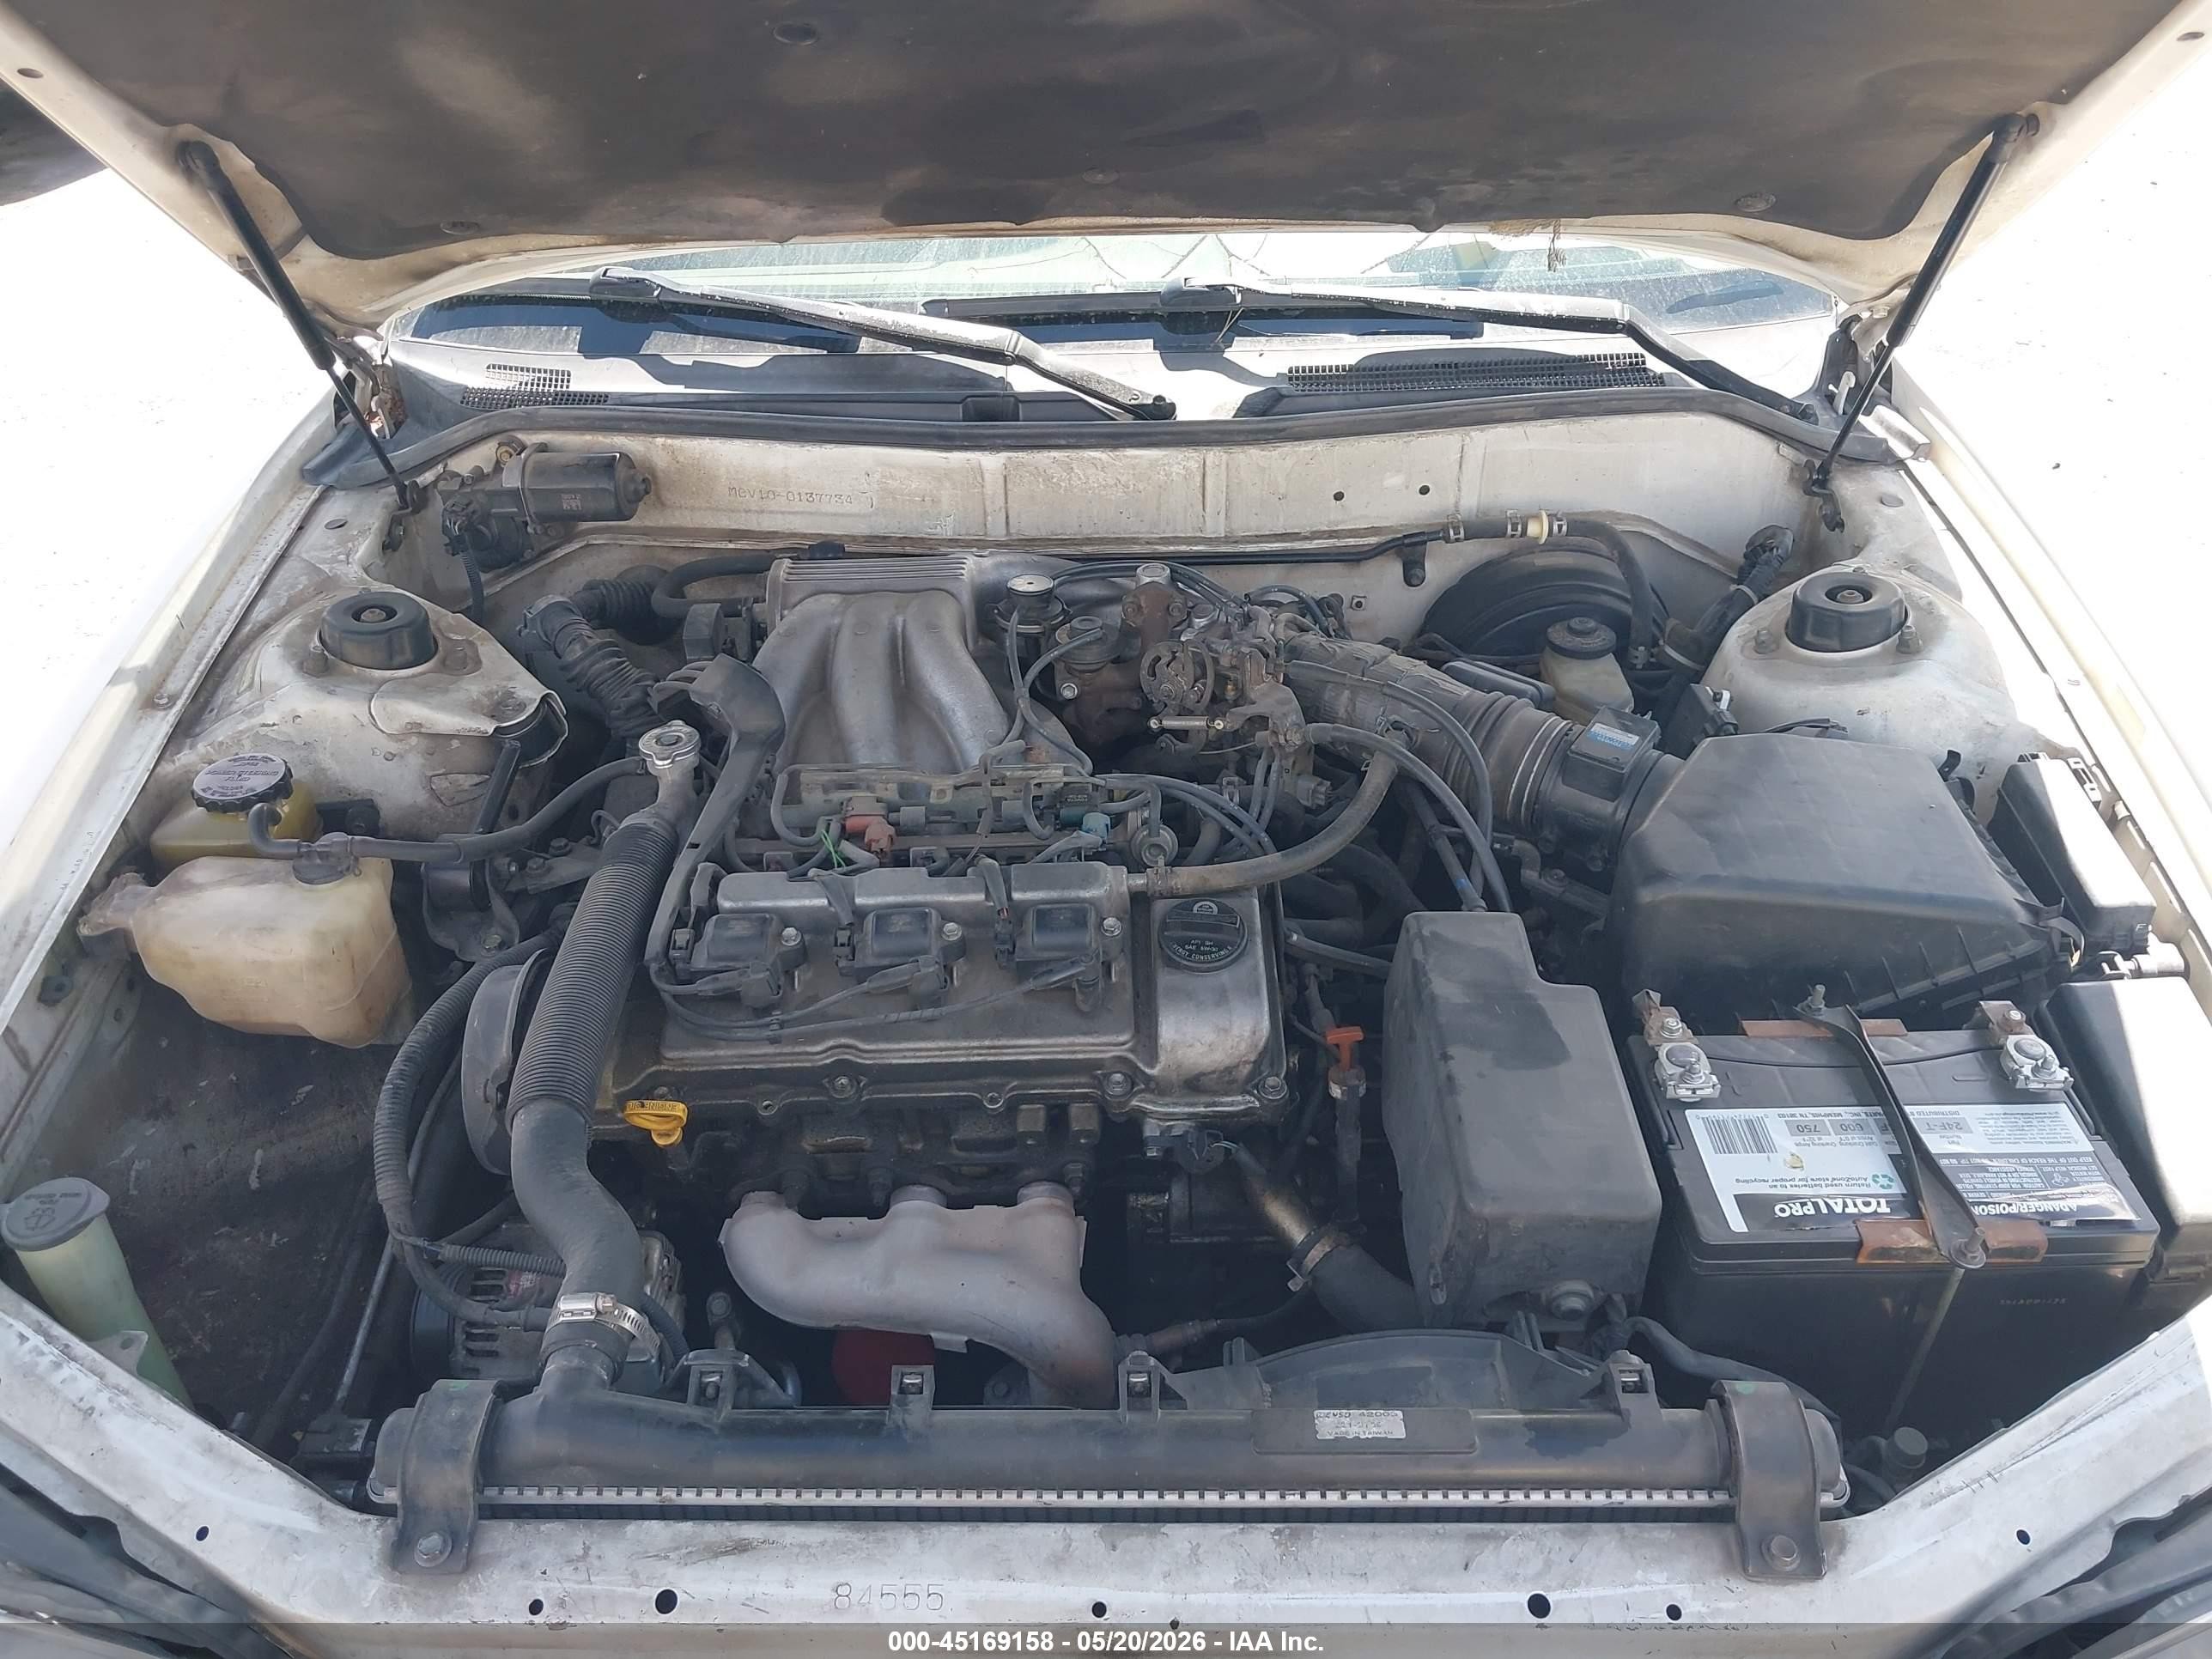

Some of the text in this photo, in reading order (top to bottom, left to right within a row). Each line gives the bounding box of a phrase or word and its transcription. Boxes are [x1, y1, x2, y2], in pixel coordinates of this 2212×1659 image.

[627, 1101, 678, 1112] ENGINE OIL
[1796, 1124, 1821, 1133] 750
[1840, 1123, 1864, 1133] 600
[1925, 1121, 1961, 1131] 24F-T
[834, 1582, 945, 1611] 84555
